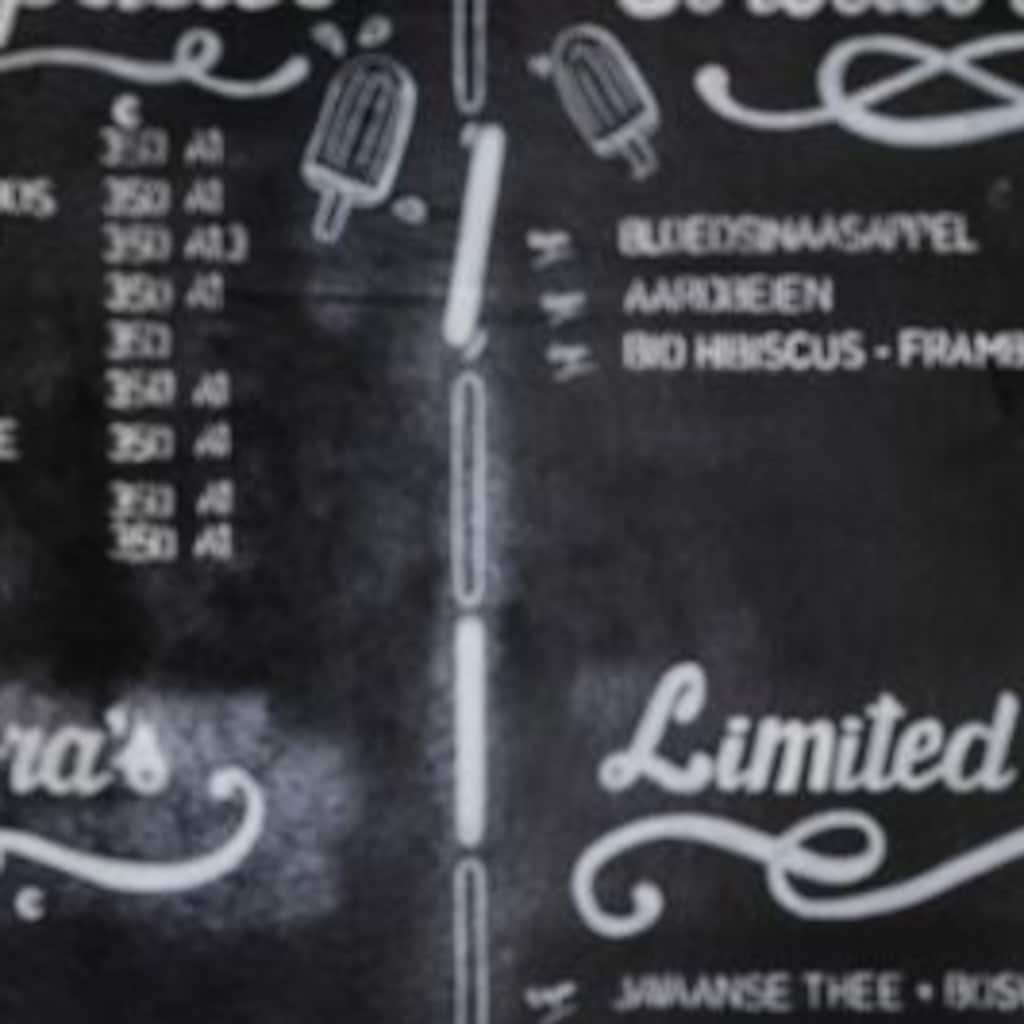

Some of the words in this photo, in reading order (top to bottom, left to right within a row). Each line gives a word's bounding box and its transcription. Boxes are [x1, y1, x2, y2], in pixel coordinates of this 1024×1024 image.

[694, 329, 867, 372] HIBISCUS
[598, 661, 1021, 794] Limited
[803, 969, 904, 1013] THEE
